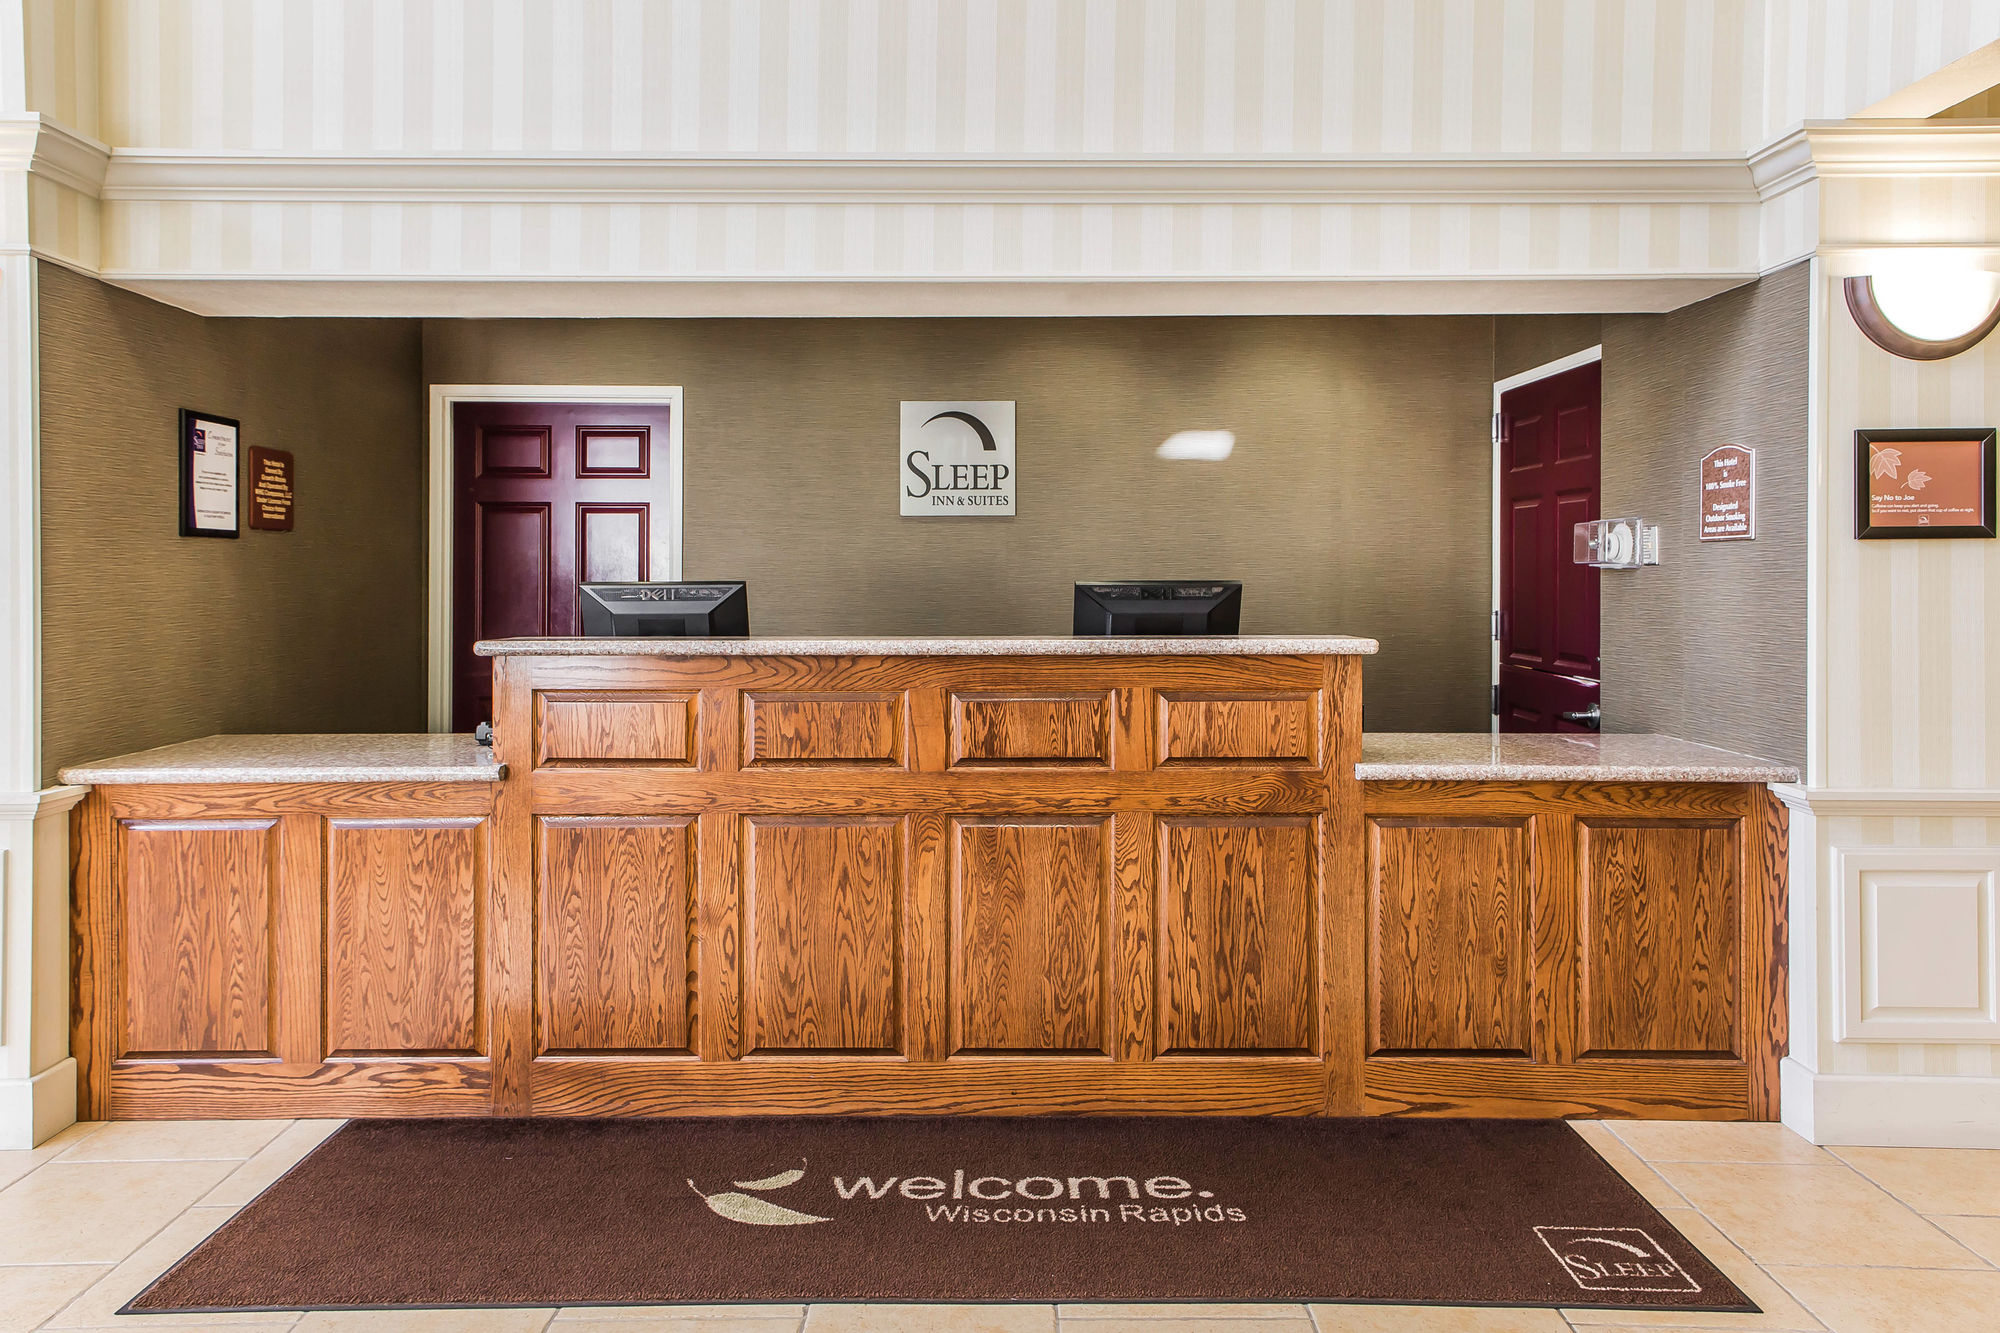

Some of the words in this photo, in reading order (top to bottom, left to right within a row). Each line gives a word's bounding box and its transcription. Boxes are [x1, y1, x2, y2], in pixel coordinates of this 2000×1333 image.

[1713, 459, 1724, 468] This
[1724, 456, 1738, 467] Hotel
[907, 450, 1010, 498] SLEEP
[1723, 469, 1728, 478] is
[1705, 482, 1719, 491] 100%
[1719, 479, 1736, 489] Smoke
[1735, 478, 1747, 488] Free
[932, 495, 955, 506] INN
[957, 495, 965, 506] &
[968, 495, 1009, 506] SUITES
[1871, 494, 1883, 502] Say
[1712, 500, 1739, 513] Designated
[1705, 513, 1725, 523] Outdoor
[1725, 511, 1746, 524] Smoking
[1704, 525, 1717, 534] Areas
[1725, 522, 1748, 532] Available
[833, 1168, 1215, 1200] welcome.
[925, 1203, 1110, 1223] Wisconsin
[1118, 1202, 1247, 1226] Rapids
[1563, 1253, 1677, 1280] SLEEP
